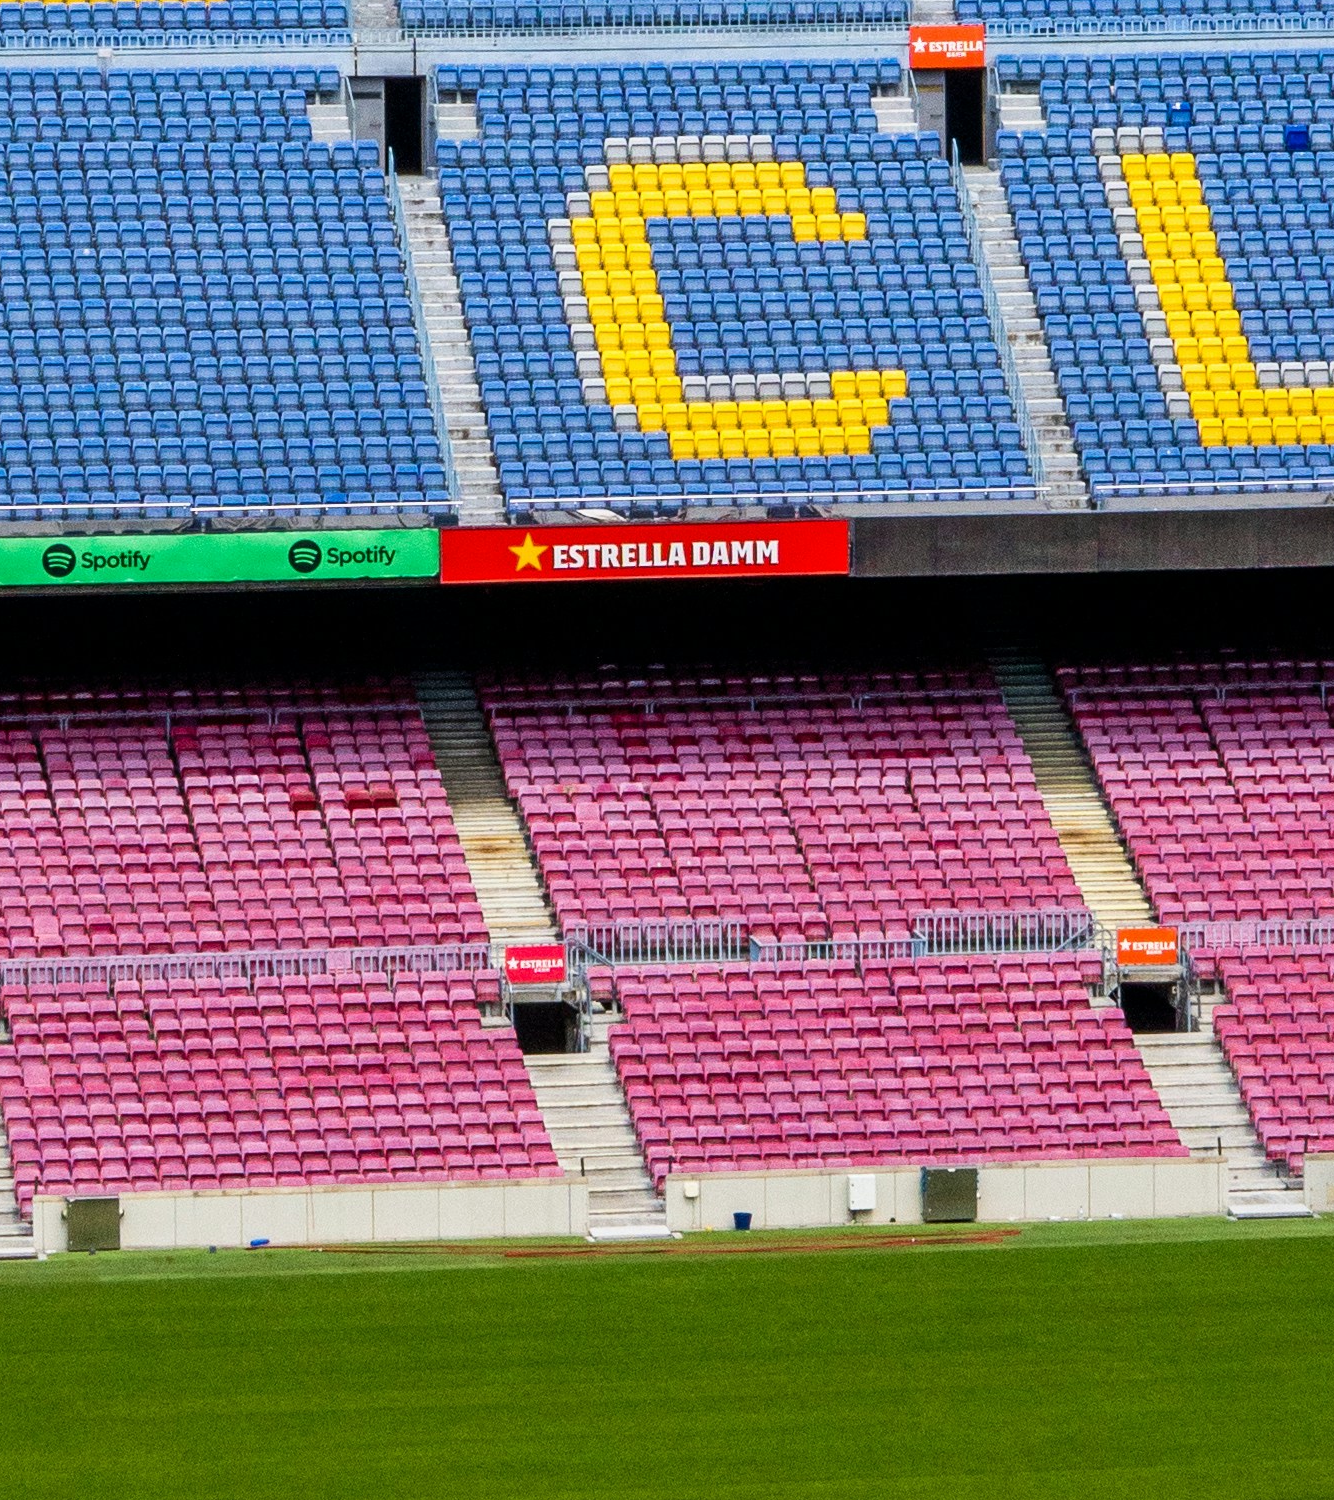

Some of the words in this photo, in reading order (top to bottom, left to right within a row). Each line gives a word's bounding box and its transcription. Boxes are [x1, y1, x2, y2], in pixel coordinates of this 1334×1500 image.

[929, 41, 984, 52] ESTRELLA
[80, 549, 150, 571] Spotify
[326, 544, 395, 566] Spotify
[552, 542, 687, 570] ESTRELLA
[691, 539, 779, 567] DAMM
[1133, 941, 1176, 951] ESTRELLA
[520, 959, 563, 969] ESTRELLA
